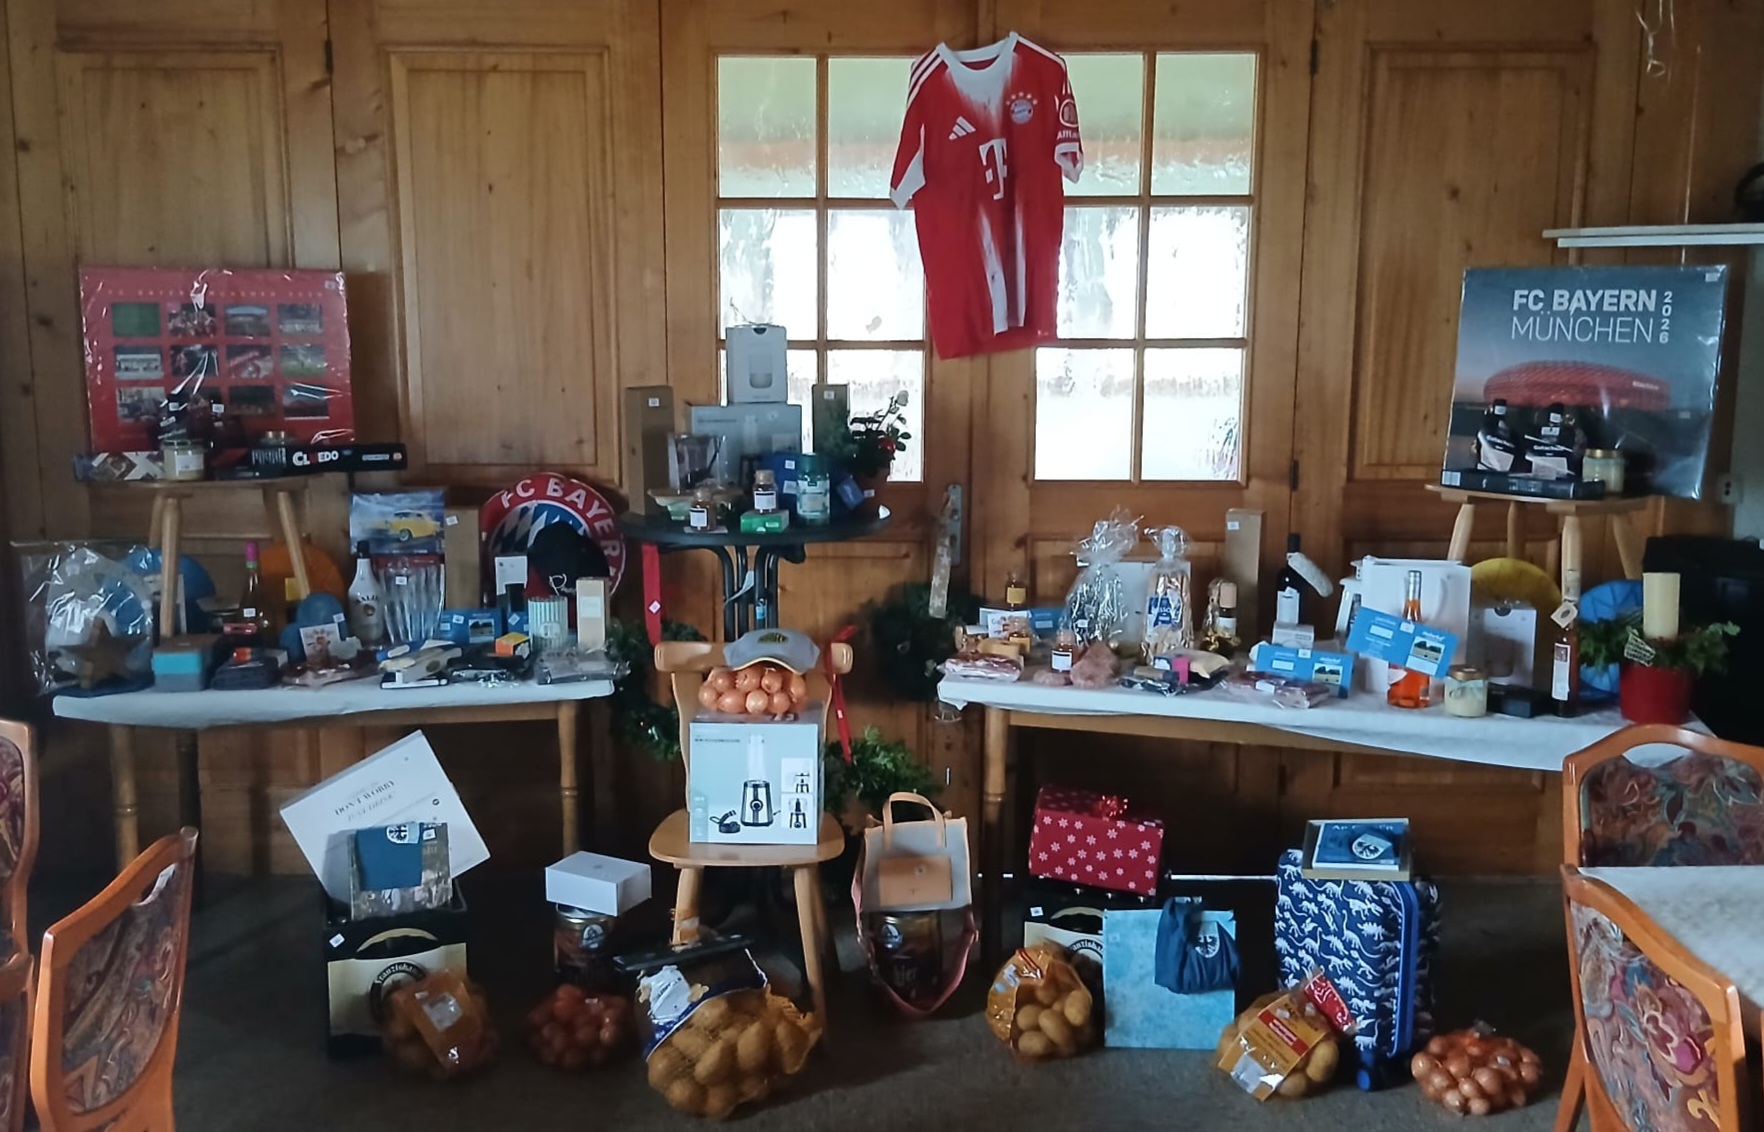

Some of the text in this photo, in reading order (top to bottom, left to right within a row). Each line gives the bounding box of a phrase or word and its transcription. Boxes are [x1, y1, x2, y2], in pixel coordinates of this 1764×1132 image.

[1512, 288, 1657, 314] FC BAYERN
[1659, 290, 1674, 344] 2026
[1511, 310, 1654, 343] MÜNCHEN
[500, 477, 622, 577] FC BAYER
